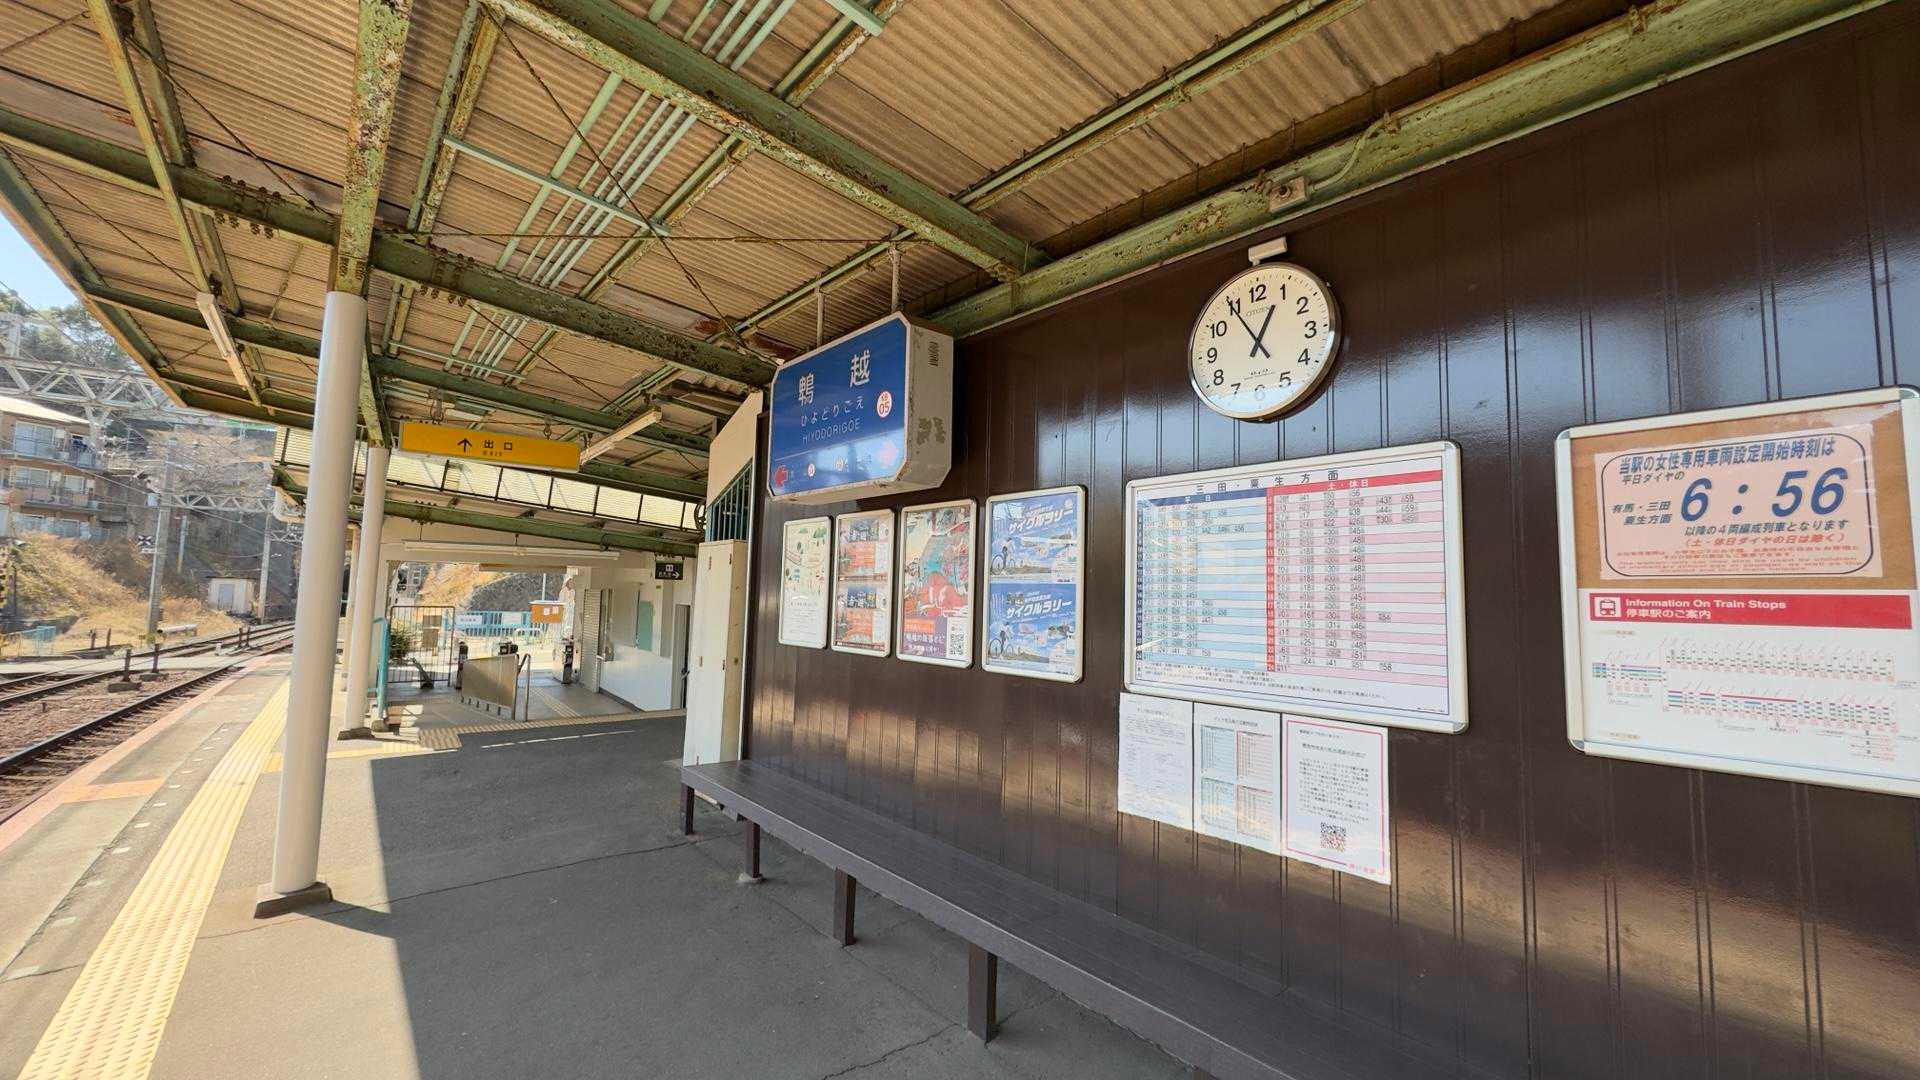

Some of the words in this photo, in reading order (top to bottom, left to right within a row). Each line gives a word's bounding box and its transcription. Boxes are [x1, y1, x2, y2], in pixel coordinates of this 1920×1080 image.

[1249, 284, 1267, 303] 12
[1279, 284, 1287, 300] 1
[1228, 298, 1241, 316] 11
[1297, 297, 1309, 315] 2
[1210, 321, 1228, 338] 10
[1304, 321, 1317, 338] 3
[1207, 348, 1218, 364] 9
[1297, 349, 1310, 365] 4
[1213, 369, 1225, 386] 8
[1279, 371, 1292, 388] 5
[1230, 383, 1241, 396] 7
[801, 396, 865, 427] ひよどりごえ
[879, 401, 890, 415] 05
[802, 418, 862, 445] HIYODORIGOE
[484, 439, 513, 451] 出口
[1619, 437, 1837, 475] 当駅の女性専用車両設定開始時刻は
[1621, 471, 1685, 485] 平日ダイヤの
[1006, 598, 1073, 619] サイクルラリー
[1625, 598, 1691, 607] Information
[1693, 598, 1711, 607] On
[1713, 599, 1746, 608] Train
[1748, 599, 1787, 610] Stops
